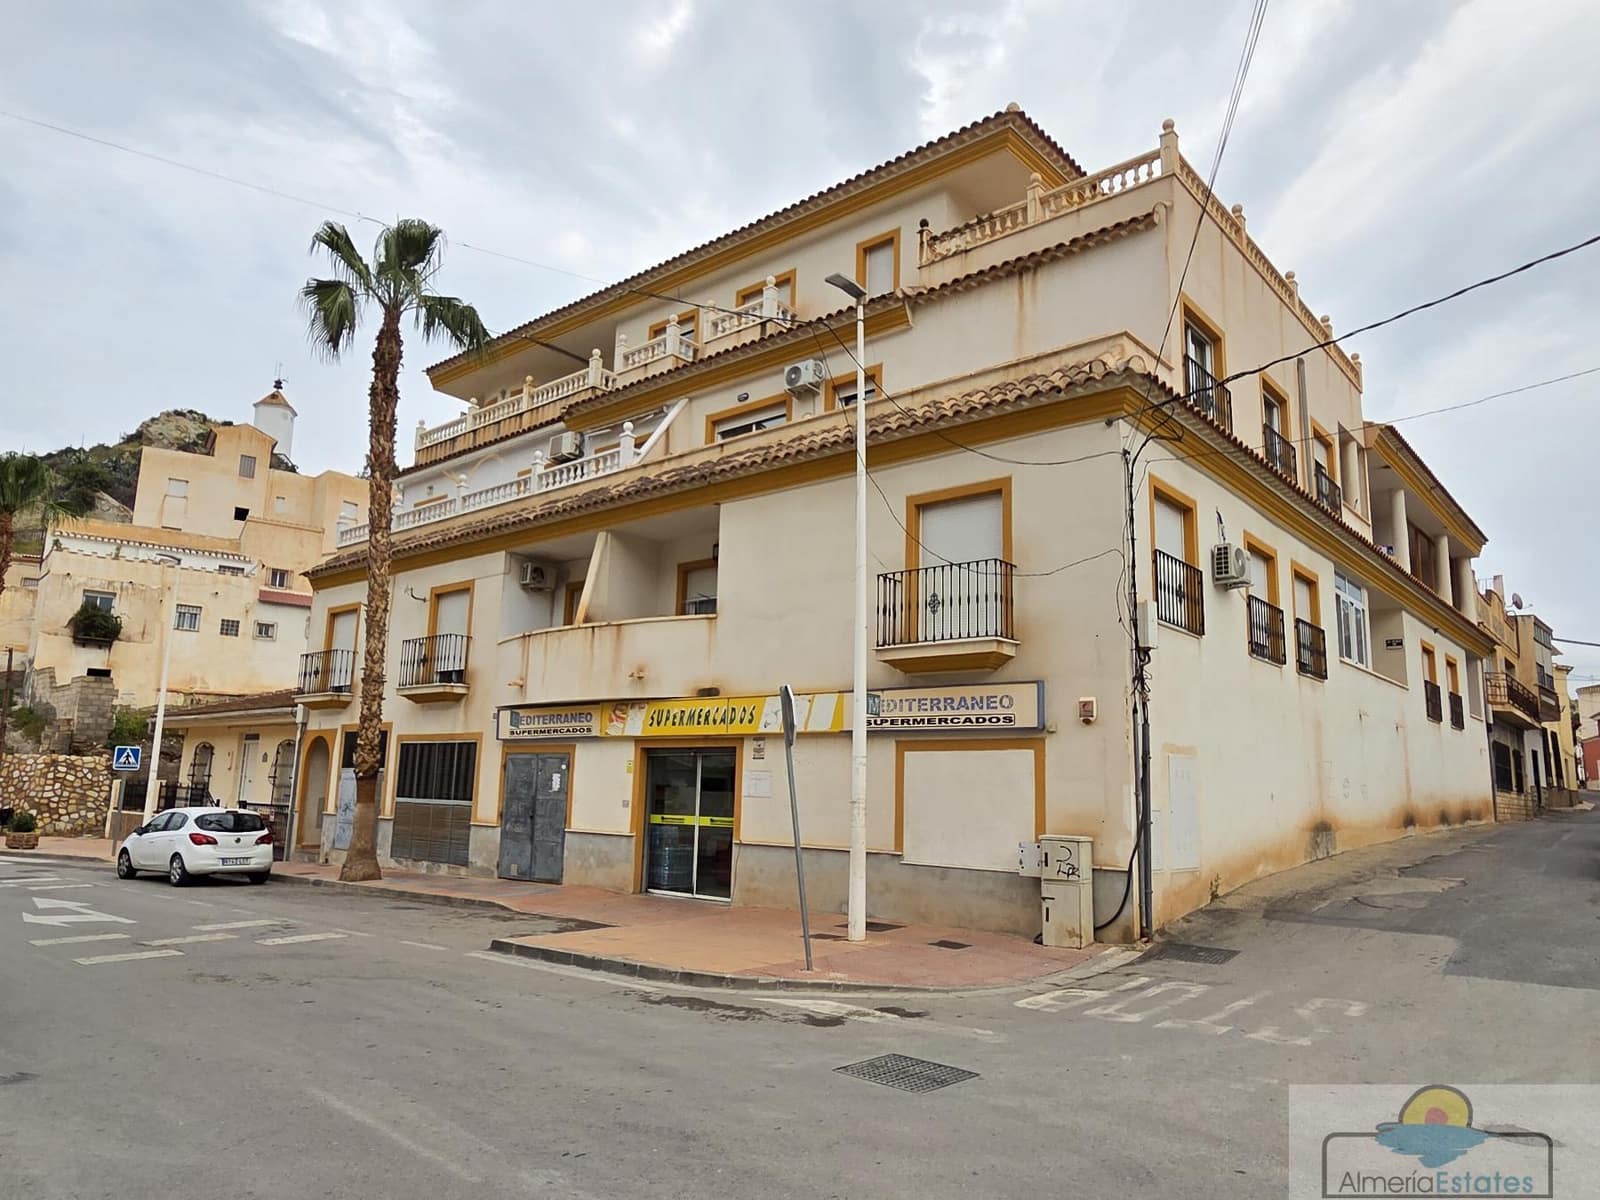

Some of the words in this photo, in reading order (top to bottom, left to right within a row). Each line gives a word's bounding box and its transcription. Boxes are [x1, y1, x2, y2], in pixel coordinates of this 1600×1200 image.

[510, 711, 593, 728] EDITERRANEO
[649, 704, 756, 727] SUPERMERCADOS
[866, 715, 1014, 727] SUPERMERCADOS
[509, 726, 592, 736] SUPERMERCADOS
